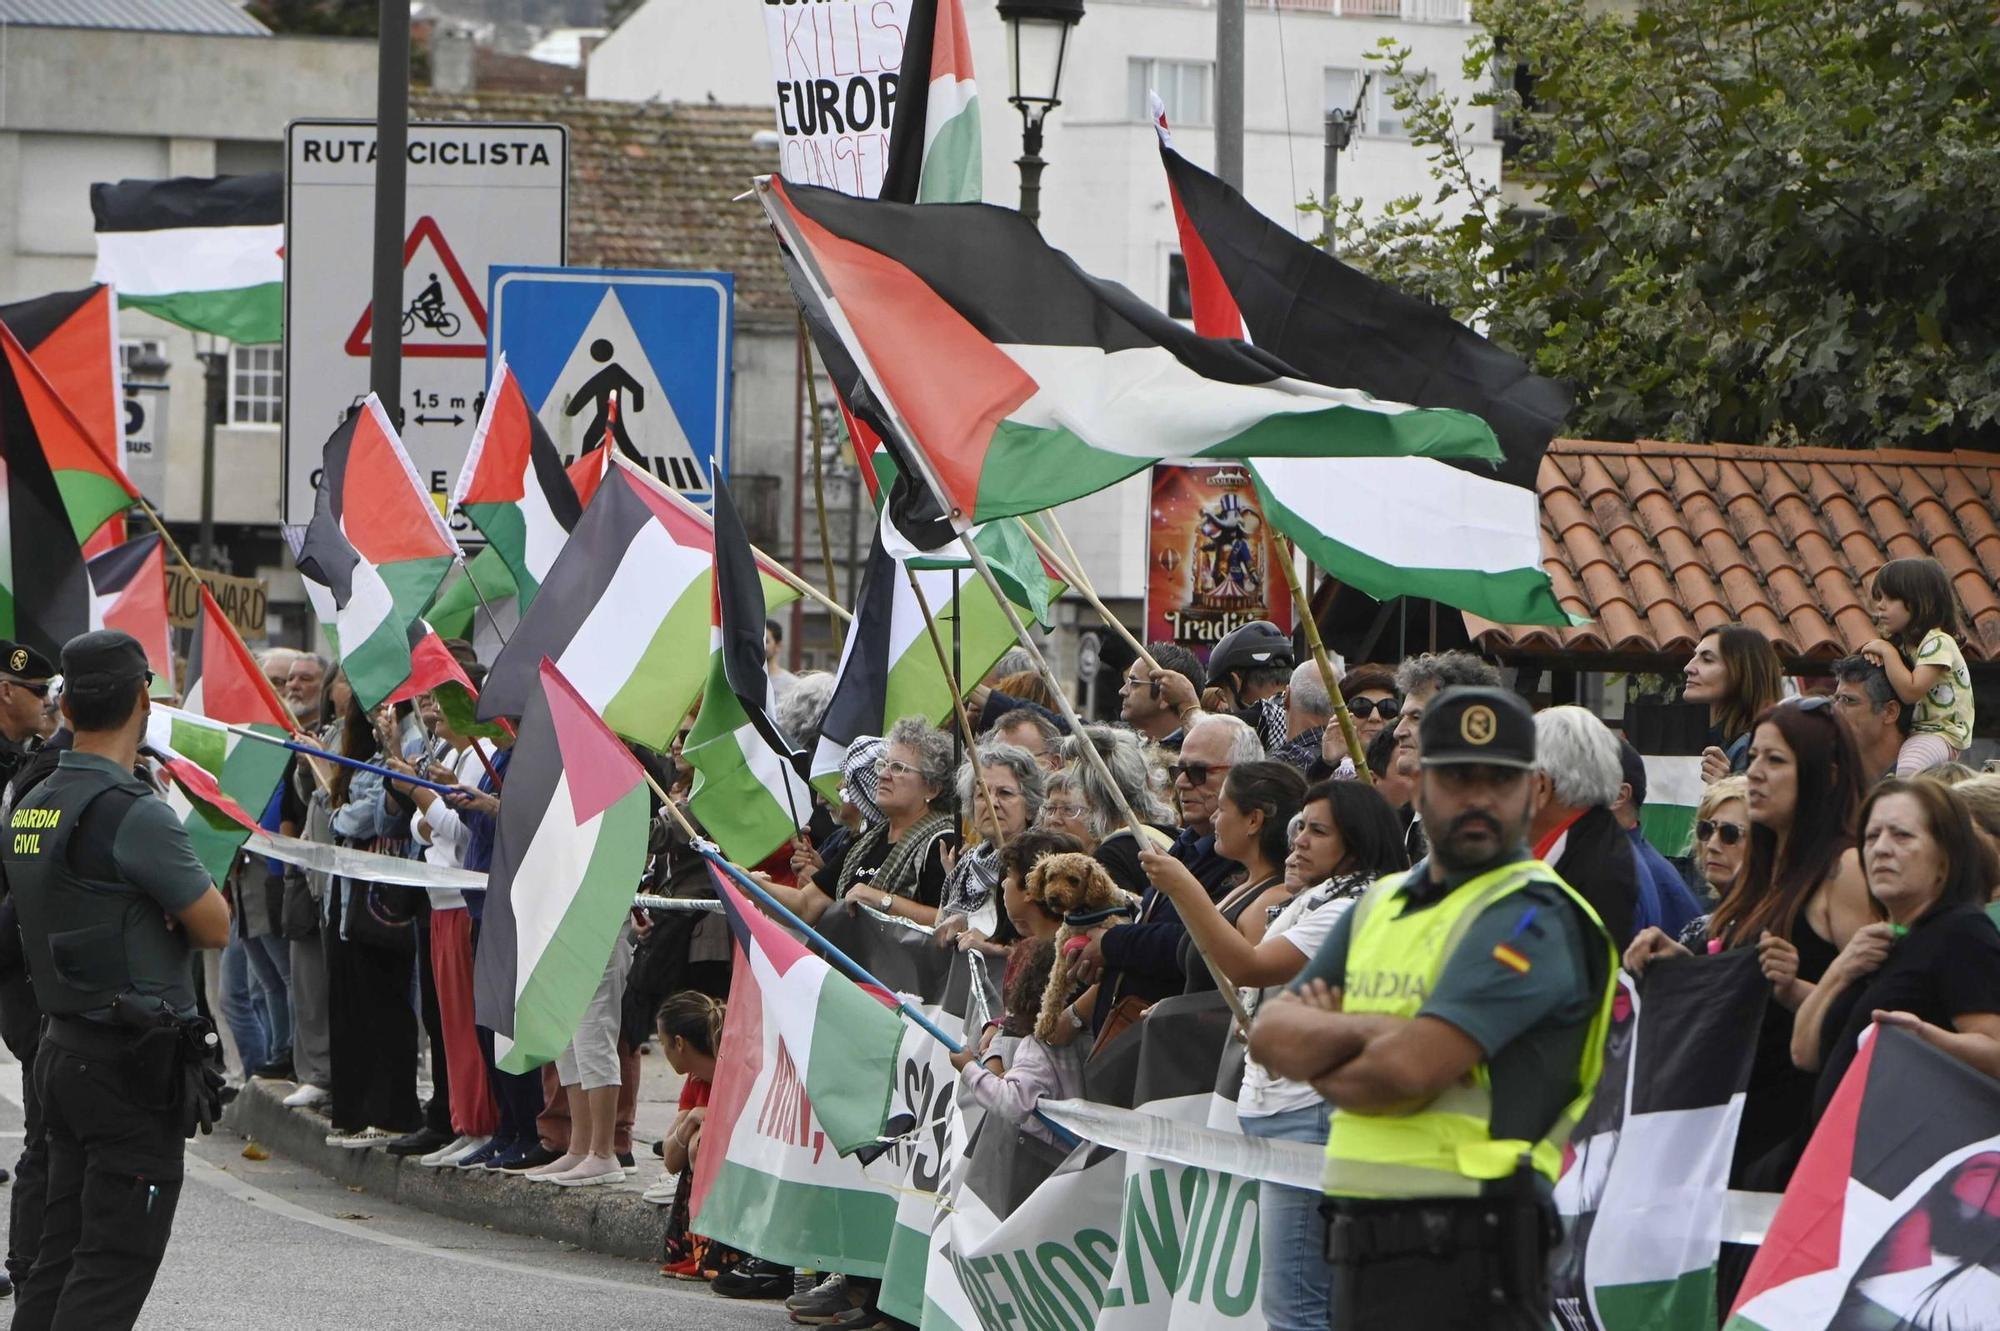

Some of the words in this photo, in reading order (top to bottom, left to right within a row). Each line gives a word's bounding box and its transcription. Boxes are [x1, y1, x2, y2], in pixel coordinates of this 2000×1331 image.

[783, 1, 905, 79] KILLS
[407, 142, 550, 166] CICLISTA
[450, 398, 465, 409] m
[11, 808, 61, 828] GUARDIA
[14, 833, 40, 854] CIVIL
